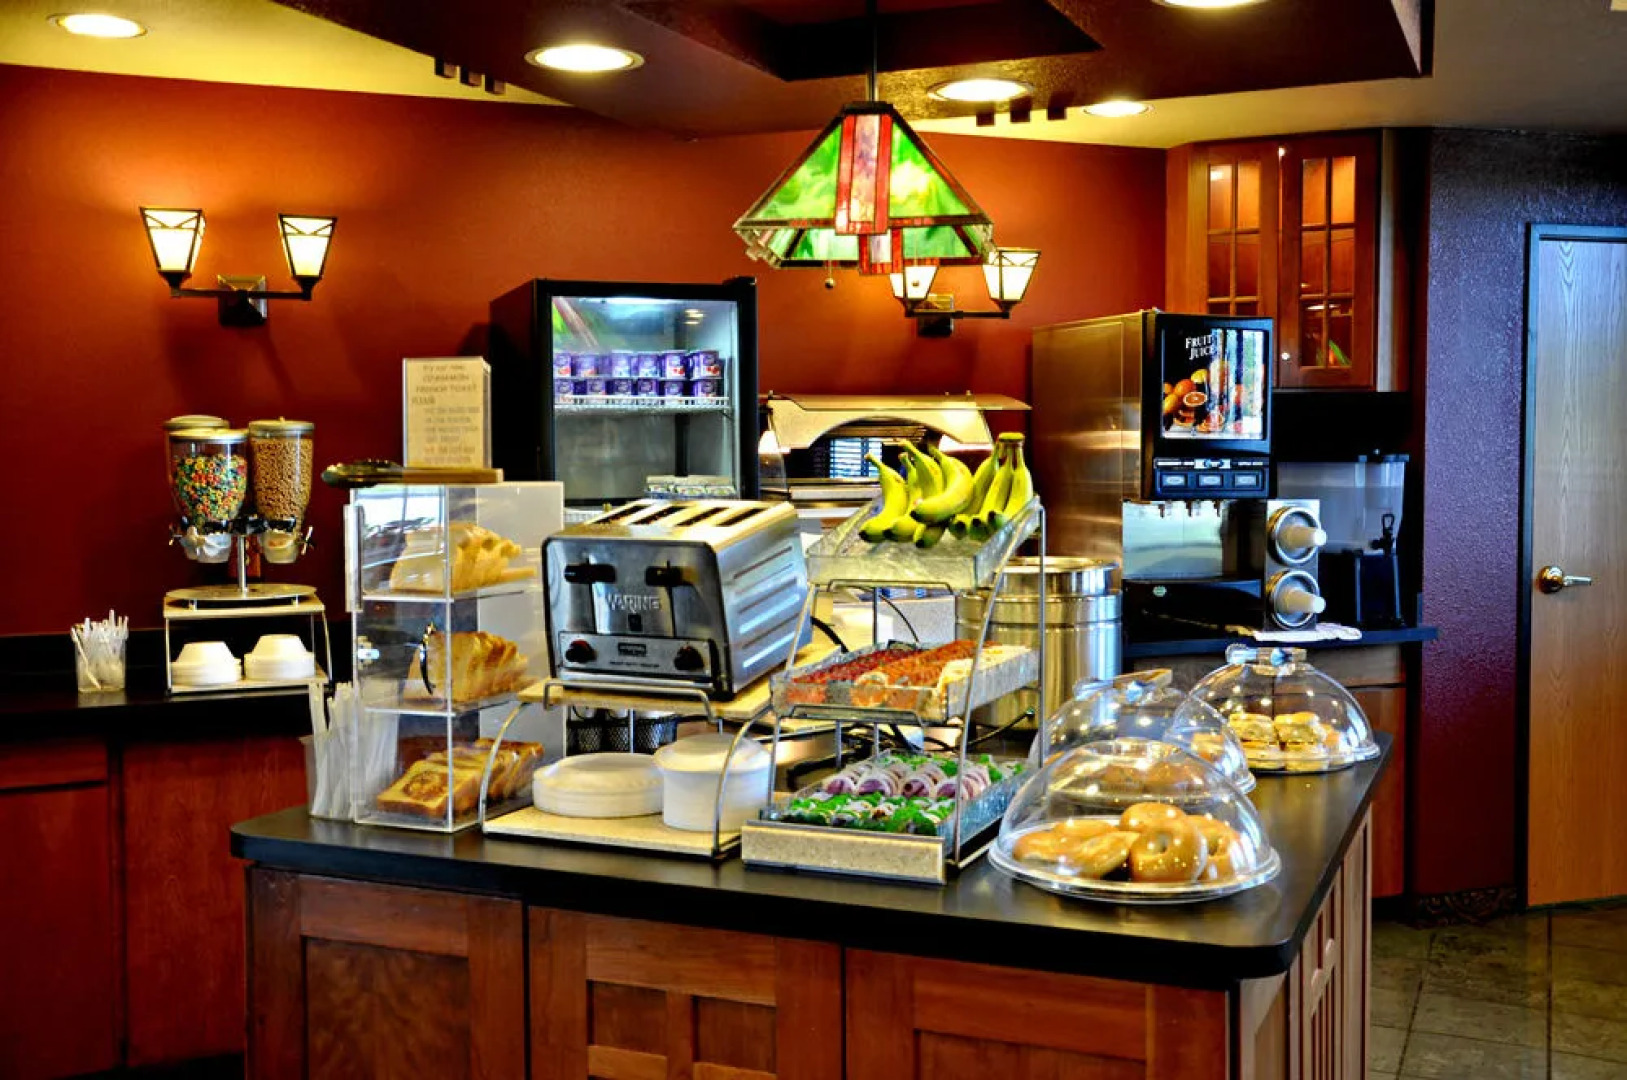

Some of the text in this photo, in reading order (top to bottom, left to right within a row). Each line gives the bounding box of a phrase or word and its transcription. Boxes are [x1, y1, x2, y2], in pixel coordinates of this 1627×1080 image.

[1185, 334, 1212, 349] FRUIT
[1189, 346, 1216, 360] JUICE
[606, 593, 660, 614] WARING
